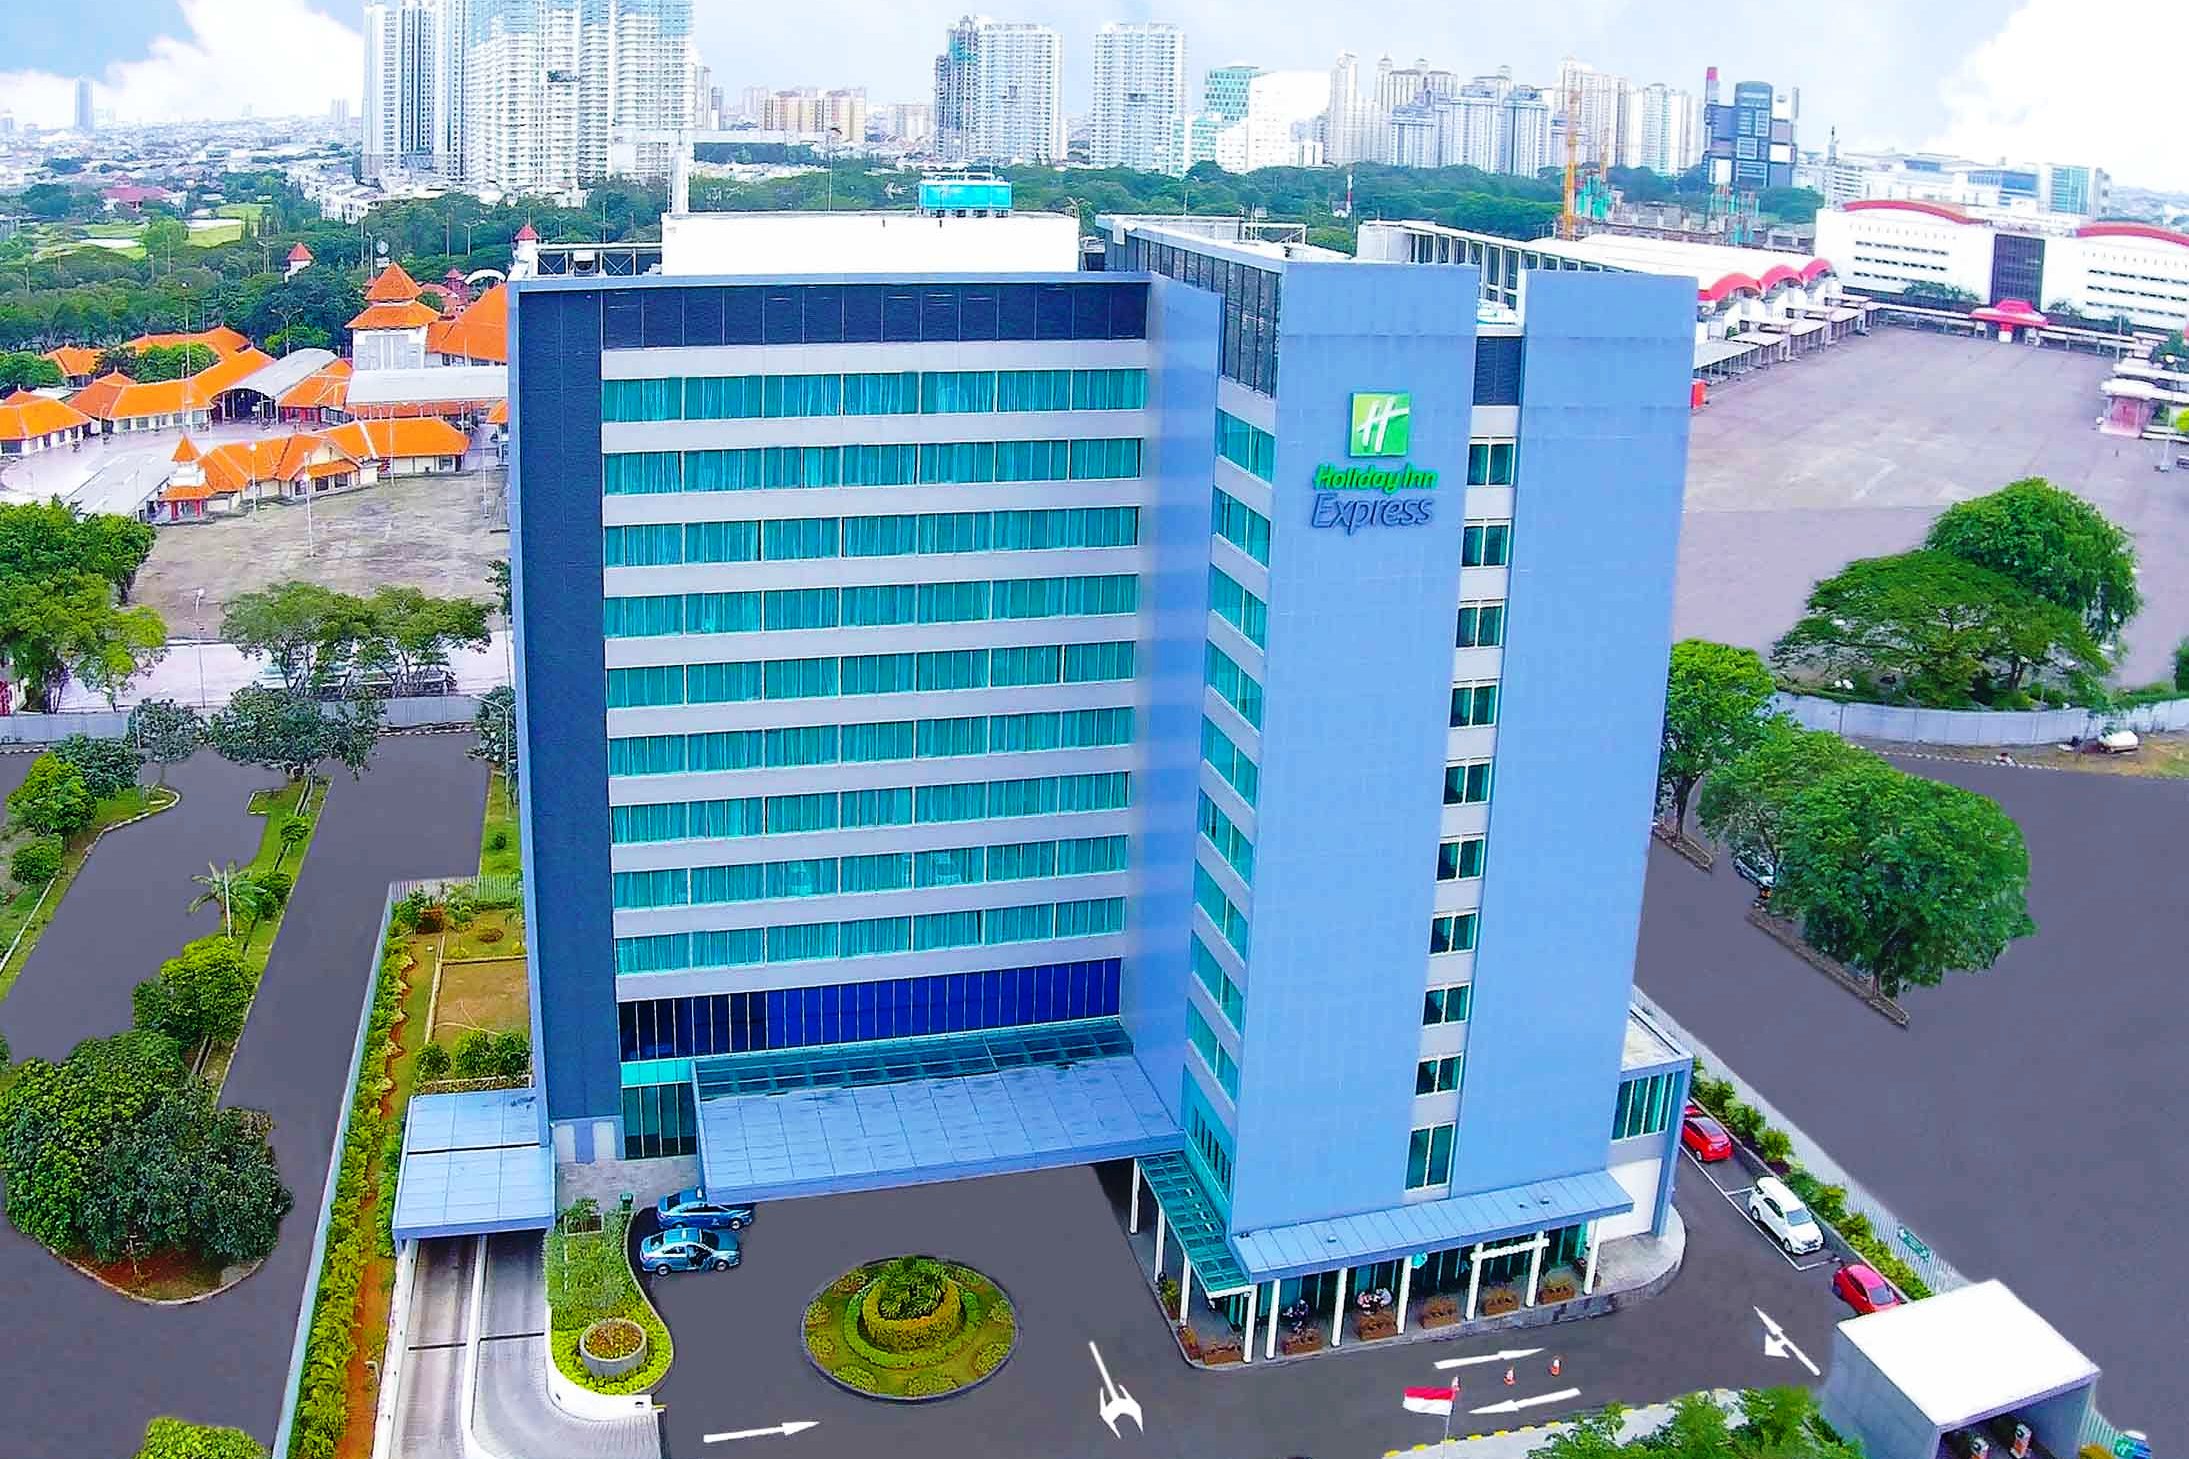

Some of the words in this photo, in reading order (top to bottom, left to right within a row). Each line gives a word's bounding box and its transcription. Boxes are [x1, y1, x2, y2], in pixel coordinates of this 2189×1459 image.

[1314, 464, 1399, 494] Holiday
[1402, 463, 1438, 488] Inn
[1311, 493, 1434, 535] Express
